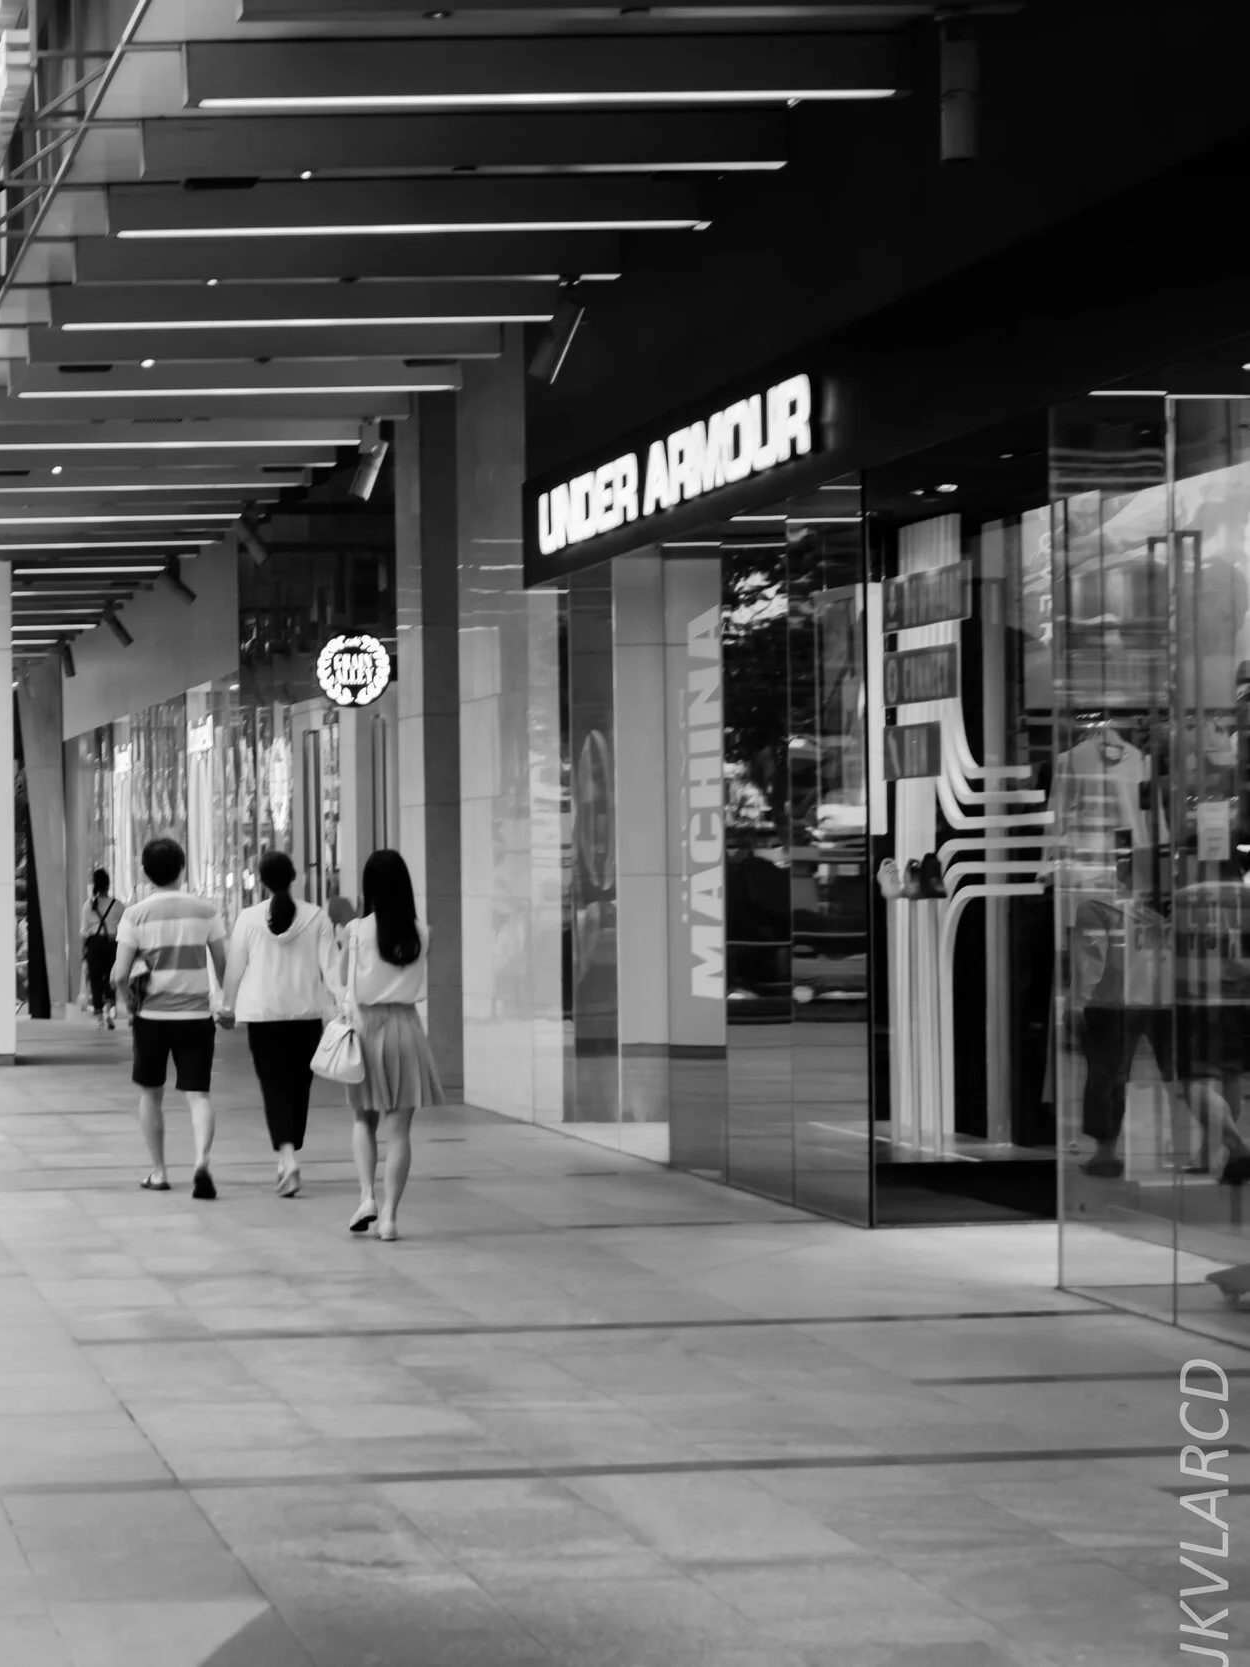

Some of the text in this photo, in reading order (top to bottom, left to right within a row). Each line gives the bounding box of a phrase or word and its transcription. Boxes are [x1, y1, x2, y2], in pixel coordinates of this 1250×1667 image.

[538, 373, 812, 556] UNDER ARMOUR
[687, 603, 726, 1000] MACHINA
